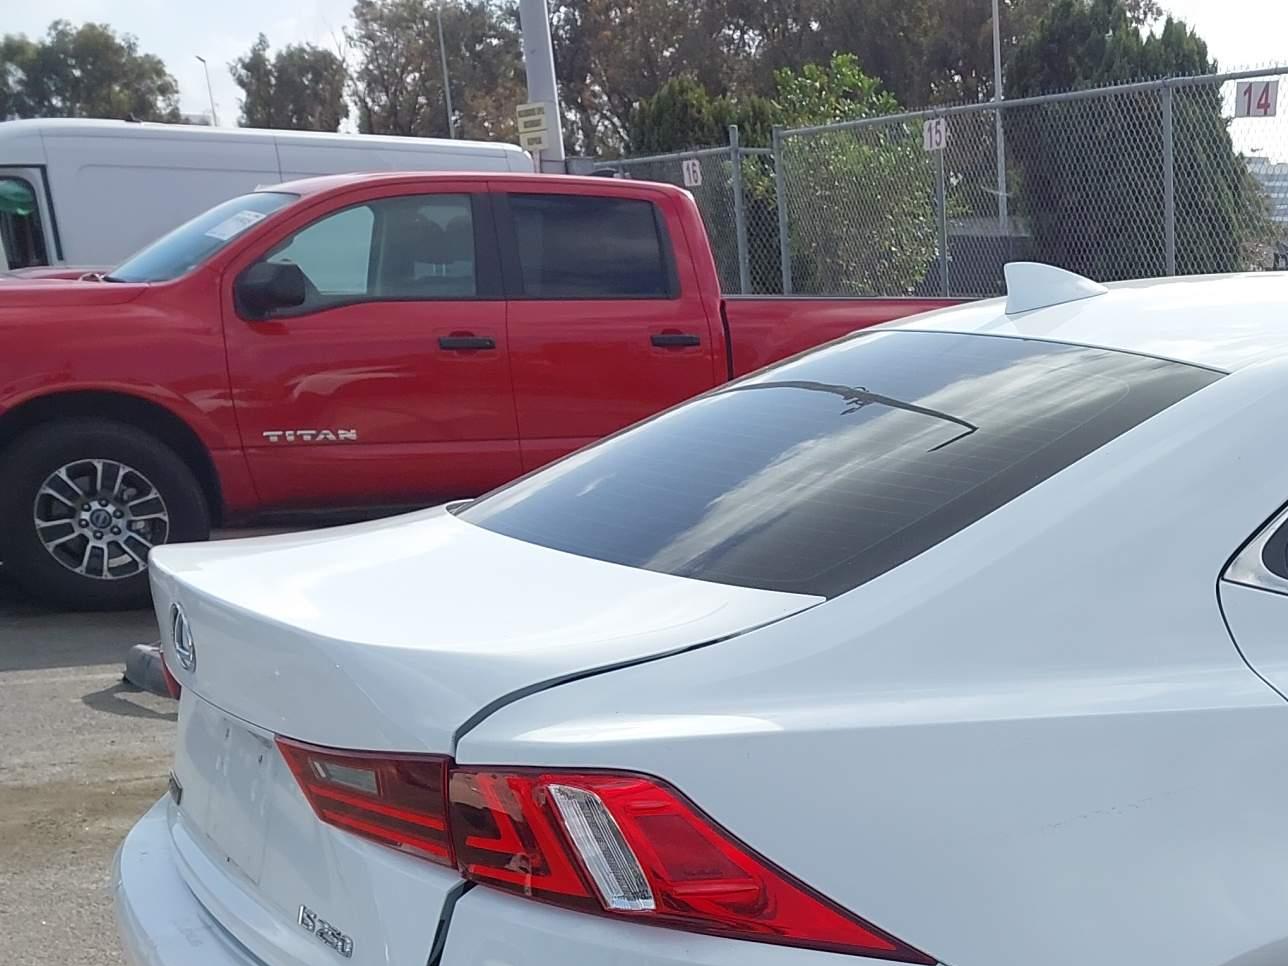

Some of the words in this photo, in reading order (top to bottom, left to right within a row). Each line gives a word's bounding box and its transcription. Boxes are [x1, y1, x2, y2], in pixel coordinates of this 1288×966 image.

[1243, 81, 1271, 115] 14
[928, 121, 942, 148] 15
[687, 161, 699, 184] 16
[263, 429, 357, 442] TITAN
[298, 905, 316, 933] IS
[316, 919, 353, 958] 250
